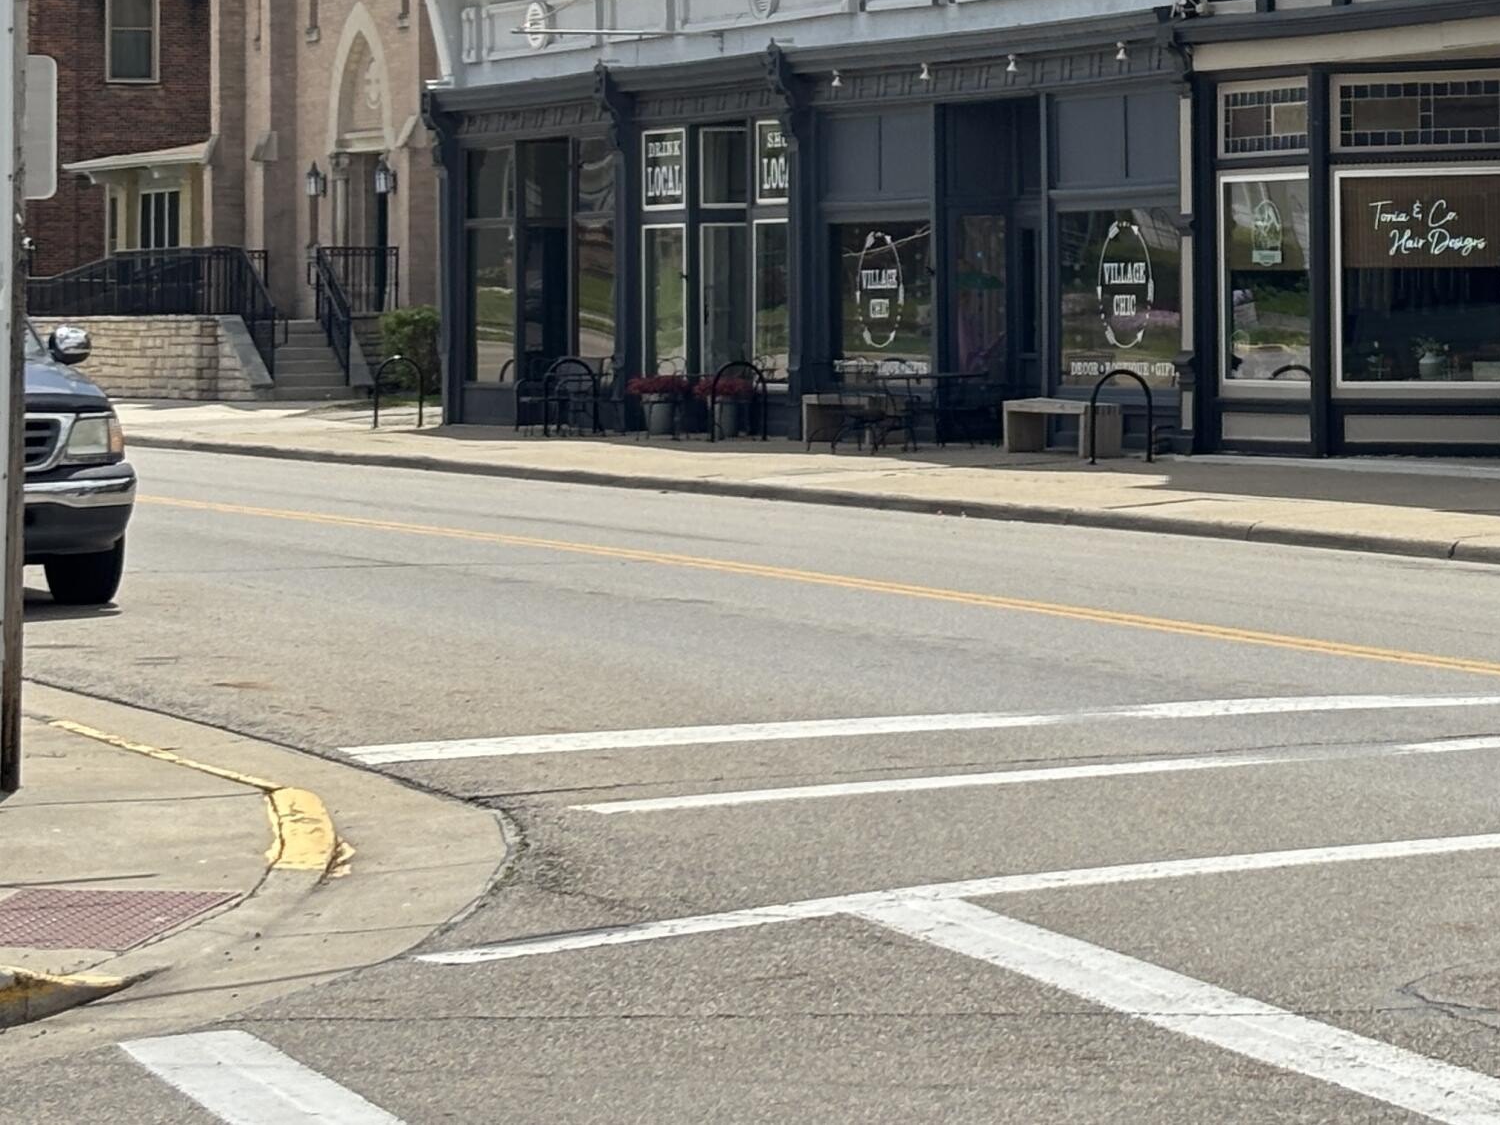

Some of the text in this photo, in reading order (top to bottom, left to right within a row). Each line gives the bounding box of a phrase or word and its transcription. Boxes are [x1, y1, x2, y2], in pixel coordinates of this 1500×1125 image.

[648, 140, 681, 158] DRINK
[647, 165, 682, 197] LOCAL
[1368, 199, 1459, 230] Tonia & Co.
[1389, 228, 1487, 256] Hair Designs
[1103, 262, 1146, 285] VILLAGE
[1113, 294, 1136, 316] CHIC
